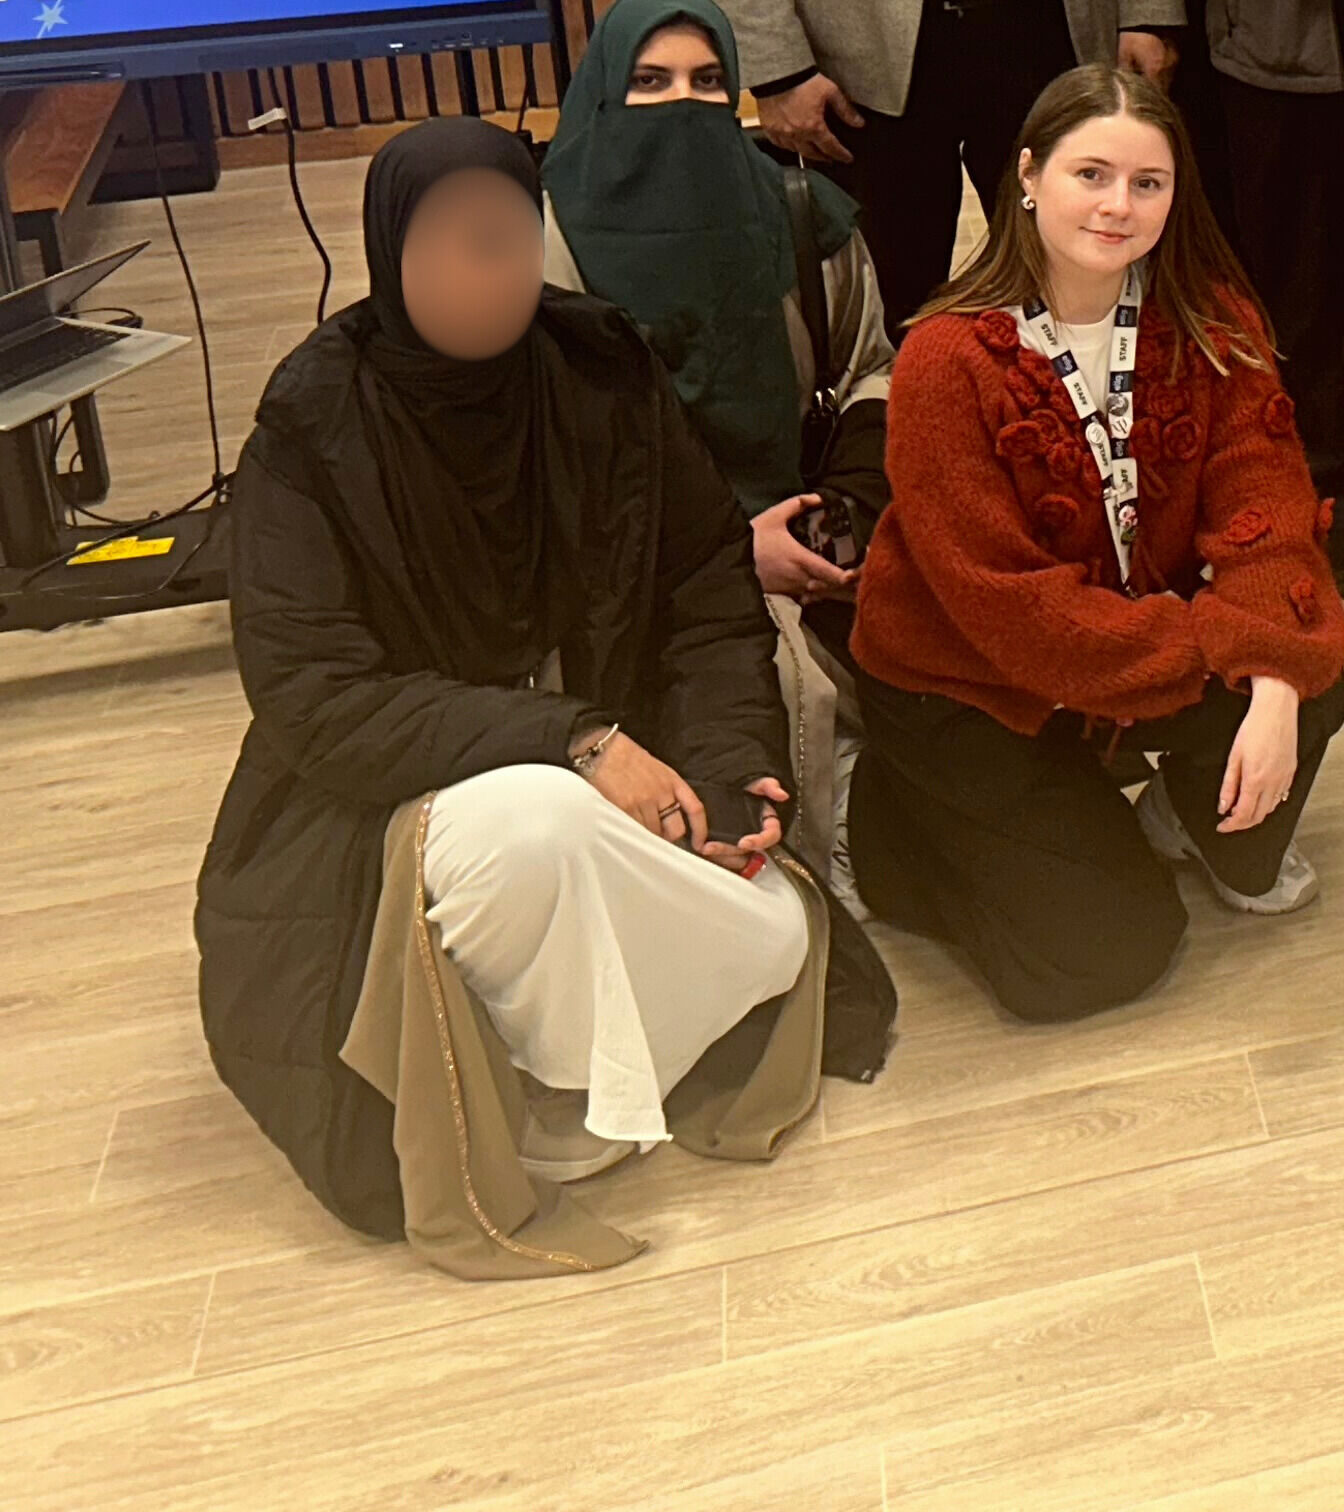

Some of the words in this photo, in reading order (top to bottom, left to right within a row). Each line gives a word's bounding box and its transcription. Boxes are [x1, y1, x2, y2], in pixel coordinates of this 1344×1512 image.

[1041, 323, 1058, 346] STAFF
[1119, 336, 1129, 362] STAFF
[1073, 382, 1088, 406] STAFF
